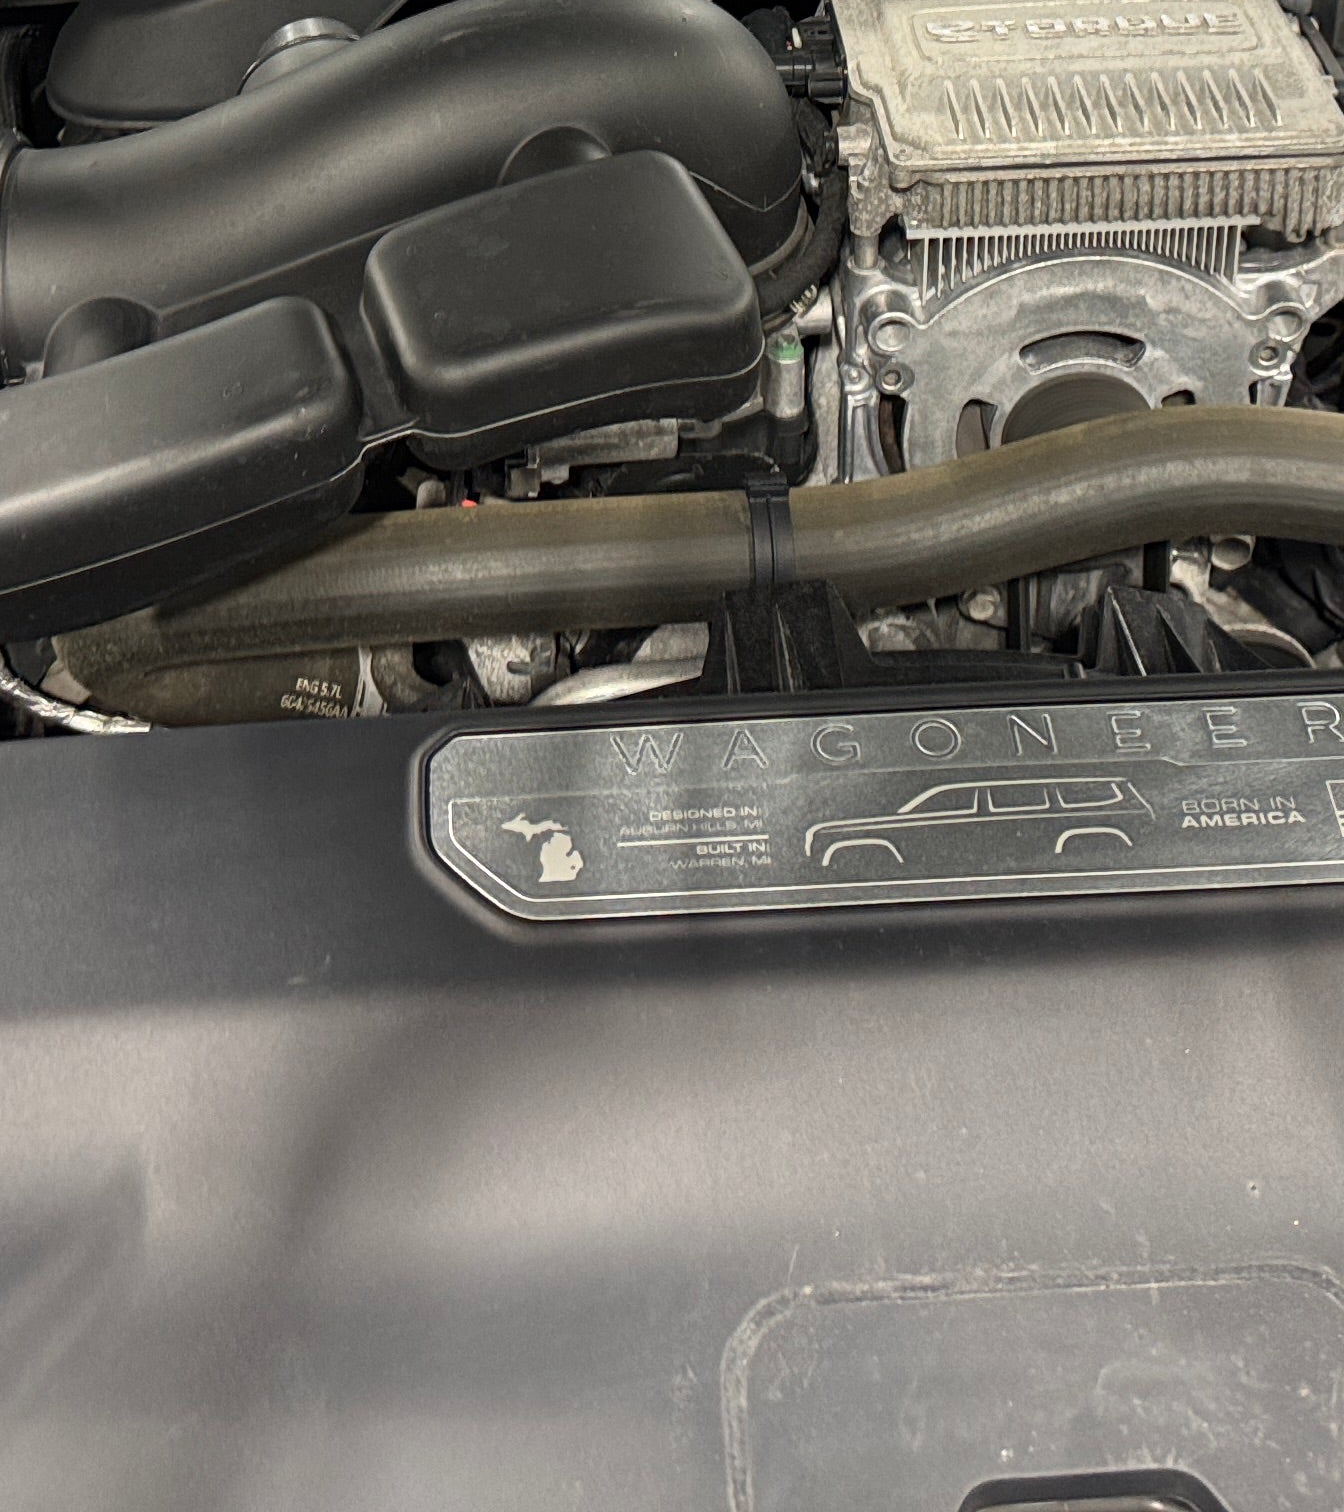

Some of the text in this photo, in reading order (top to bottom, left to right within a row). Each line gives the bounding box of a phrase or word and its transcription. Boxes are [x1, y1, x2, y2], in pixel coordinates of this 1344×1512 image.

[1181, 795, 1297, 814] BORN IN
[649, 807, 736, 822] DESIGNED
[1180, 810, 1306, 829] AMERICA
[619, 822, 688, 837] AUBURN
[696, 842, 744, 855] BUILT
